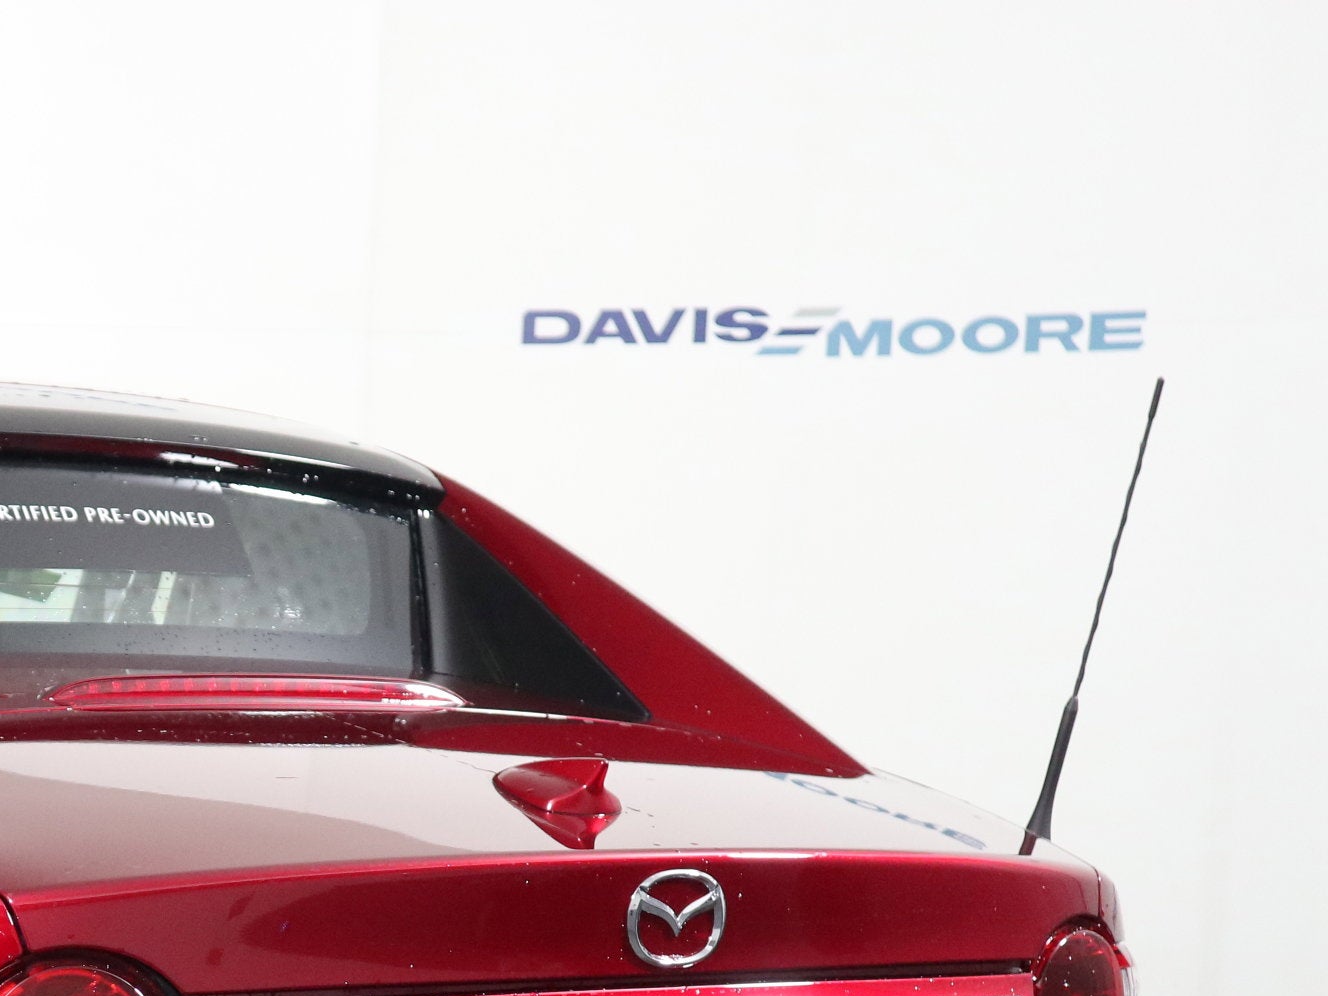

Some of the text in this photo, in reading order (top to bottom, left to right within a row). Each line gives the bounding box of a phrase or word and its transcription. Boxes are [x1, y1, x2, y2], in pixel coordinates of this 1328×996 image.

[521, 307, 1147, 357] DAVIS MOORE
[83, 506, 215, 528] PRE-OWNED
